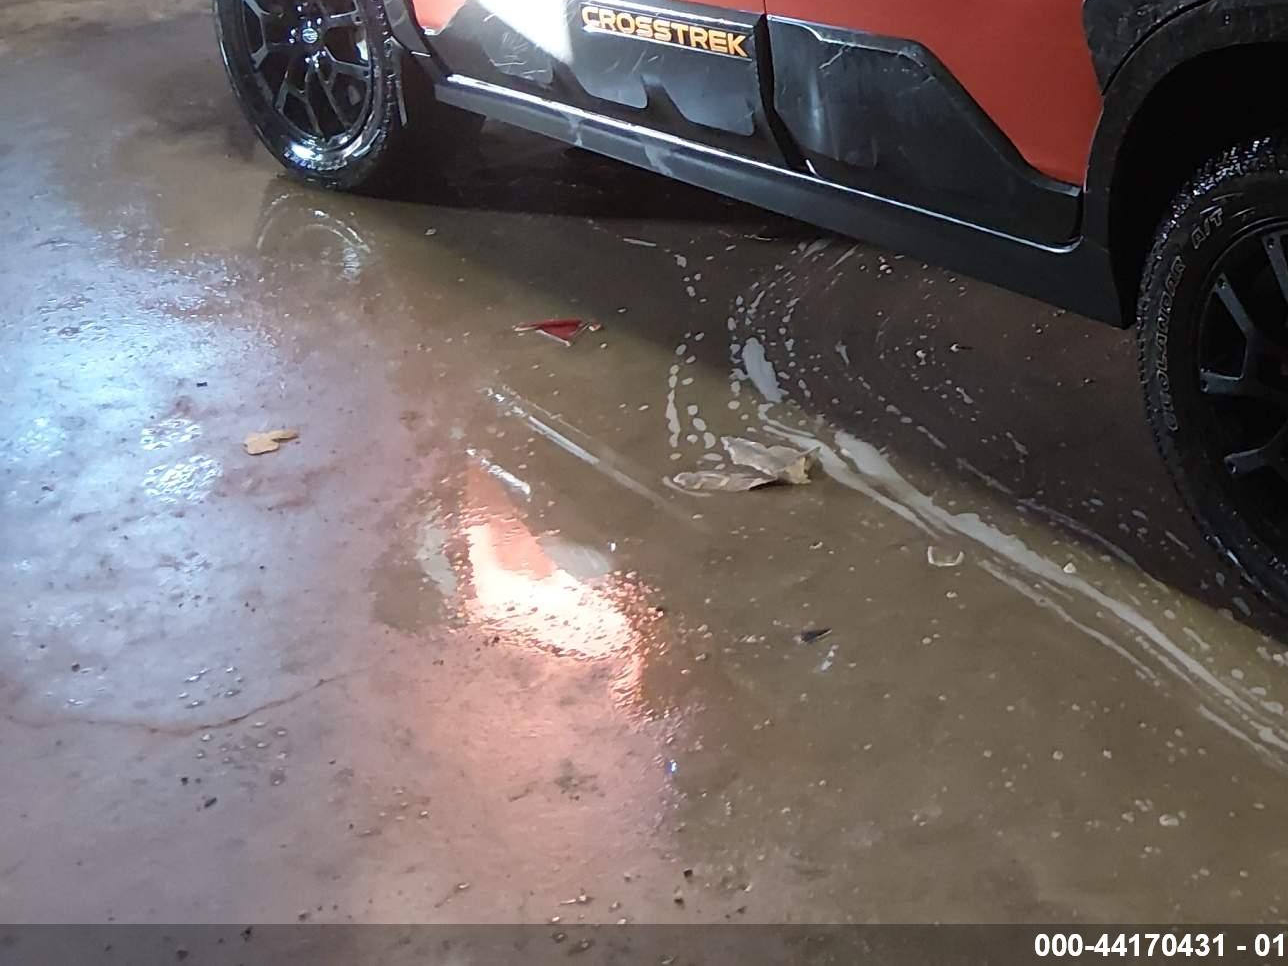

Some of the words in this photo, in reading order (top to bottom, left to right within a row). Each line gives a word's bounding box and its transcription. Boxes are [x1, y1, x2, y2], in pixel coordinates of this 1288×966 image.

[581, 5, 748, 58] CROSSTREK
[1155, 255, 1186, 432] GEOLANDAR
[1191, 207, 1224, 250] A/T
